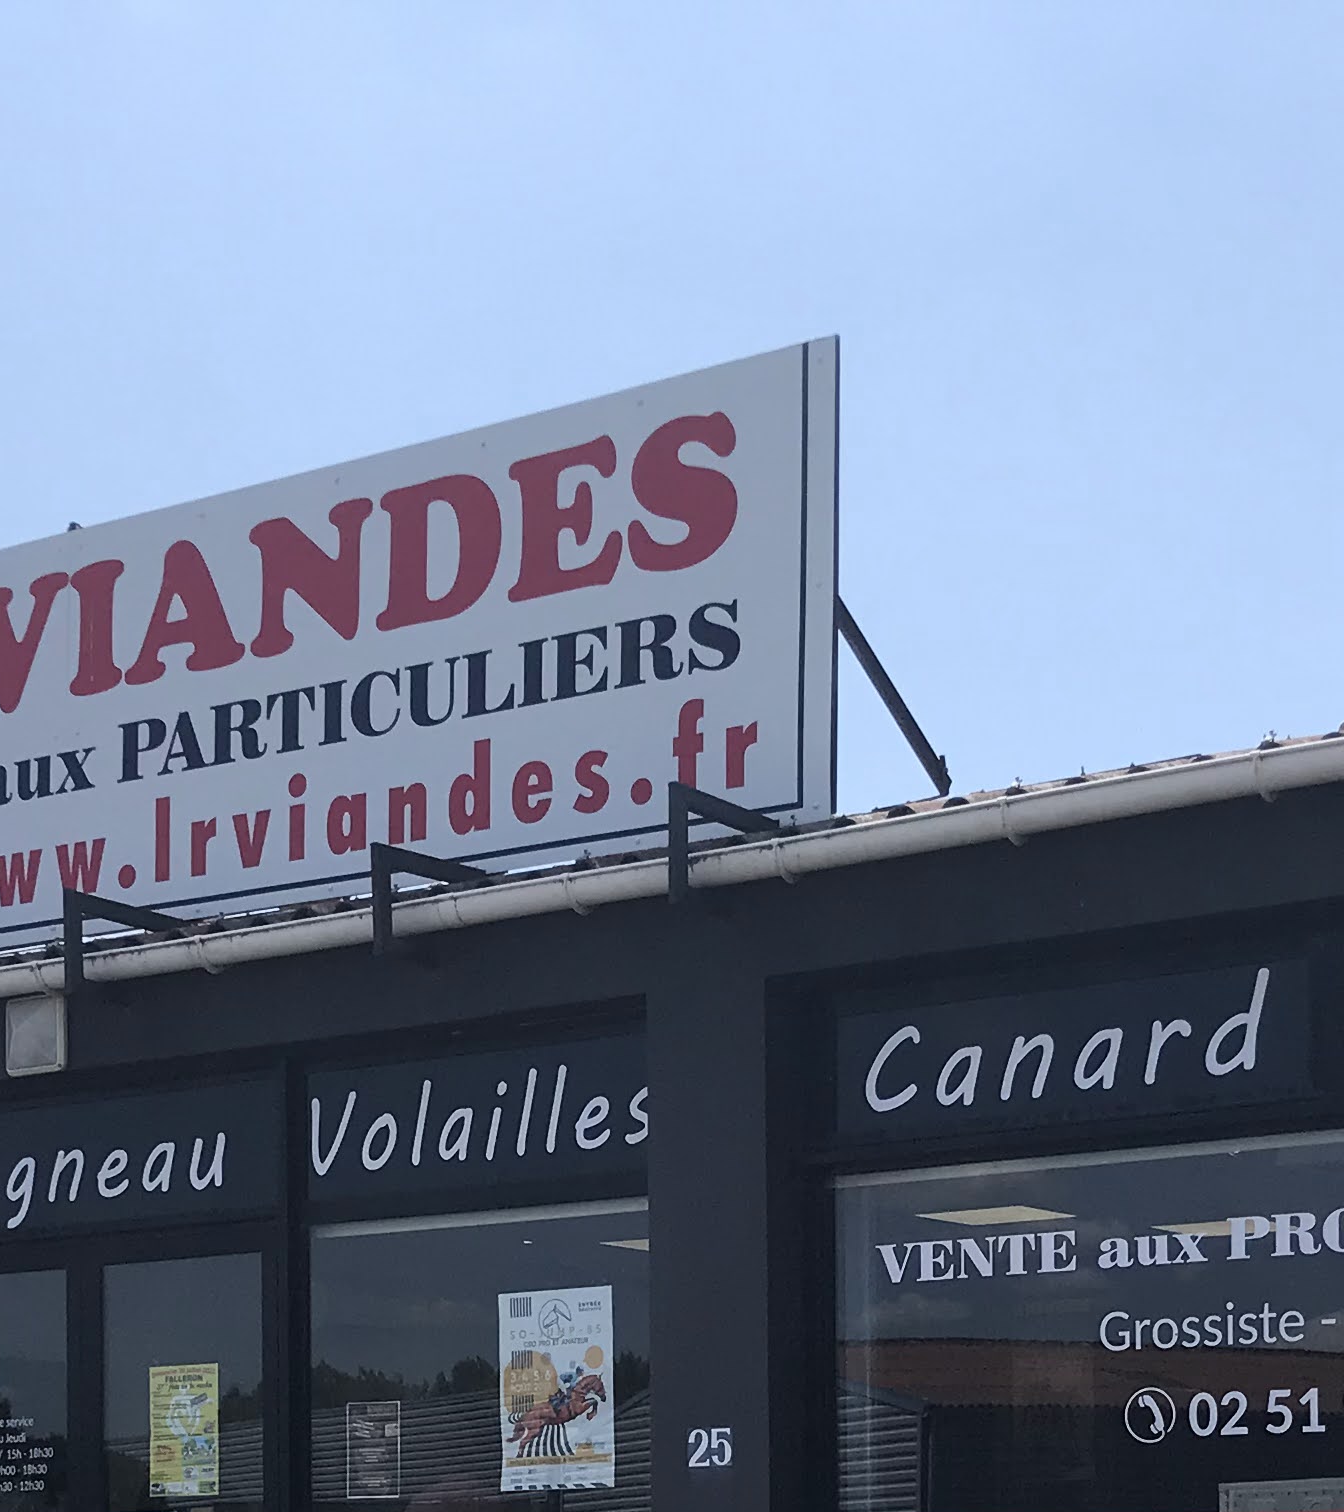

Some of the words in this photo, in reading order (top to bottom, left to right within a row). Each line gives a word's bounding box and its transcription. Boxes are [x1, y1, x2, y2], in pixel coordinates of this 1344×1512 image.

[117, 599, 740, 782] PARTICULIERS
[866, 968, 1269, 1112] Canard
[312, 1065, 648, 1174] Volailles
[875, 1230, 1076, 1283] VENTE
[1098, 1233, 1207, 1268] aux
[1100, 1302, 1304, 1351] Grossiste
[6, 1416, 34, 1428] service
[1189, 1391, 1248, 1436] 02
[1266, 1388, 1325, 1433] 51
[6, 1433, 26, 1444] Jeudi
[7, 1449, 22, 1460] 15h
[29, 1447, 54, 1459] 18h30
[688, 1428, 732, 1467] 25
[20, 1480, 44, 1491] 12h30
[23, 1464, 47, 1475] 18h30
